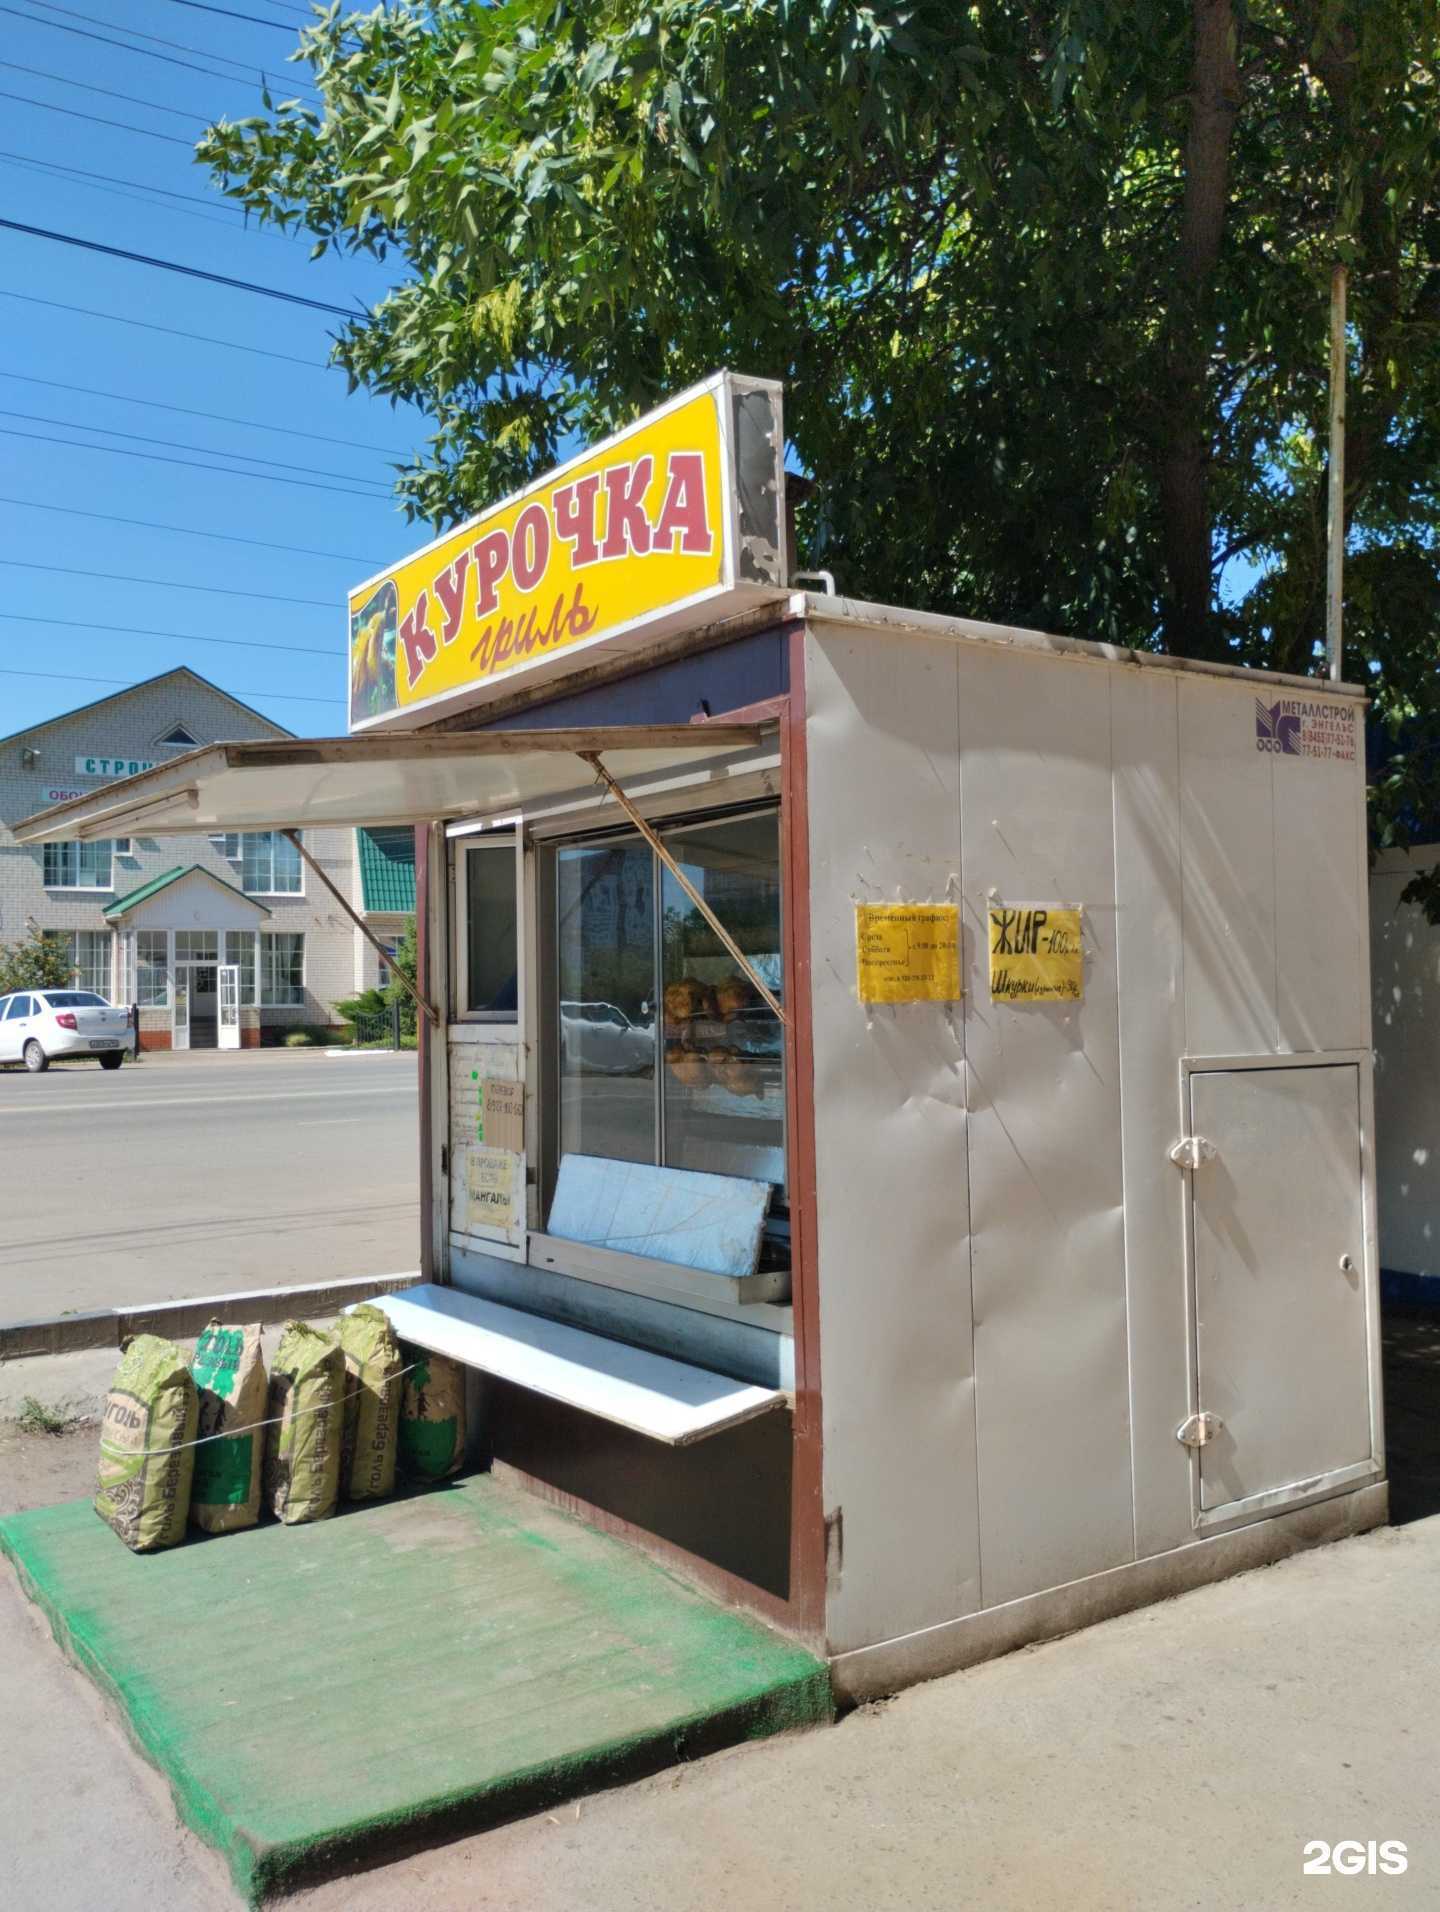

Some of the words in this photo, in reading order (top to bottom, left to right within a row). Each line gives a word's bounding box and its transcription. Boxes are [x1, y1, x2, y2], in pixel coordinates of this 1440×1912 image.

[399, 451, 713, 690] КУРОЧКА
[470, 582, 599, 675] гриль
[1281, 699, 1355, 722] МЕТАЛЛСТРОЙ
[1256, 738, 1283, 754] ООО
